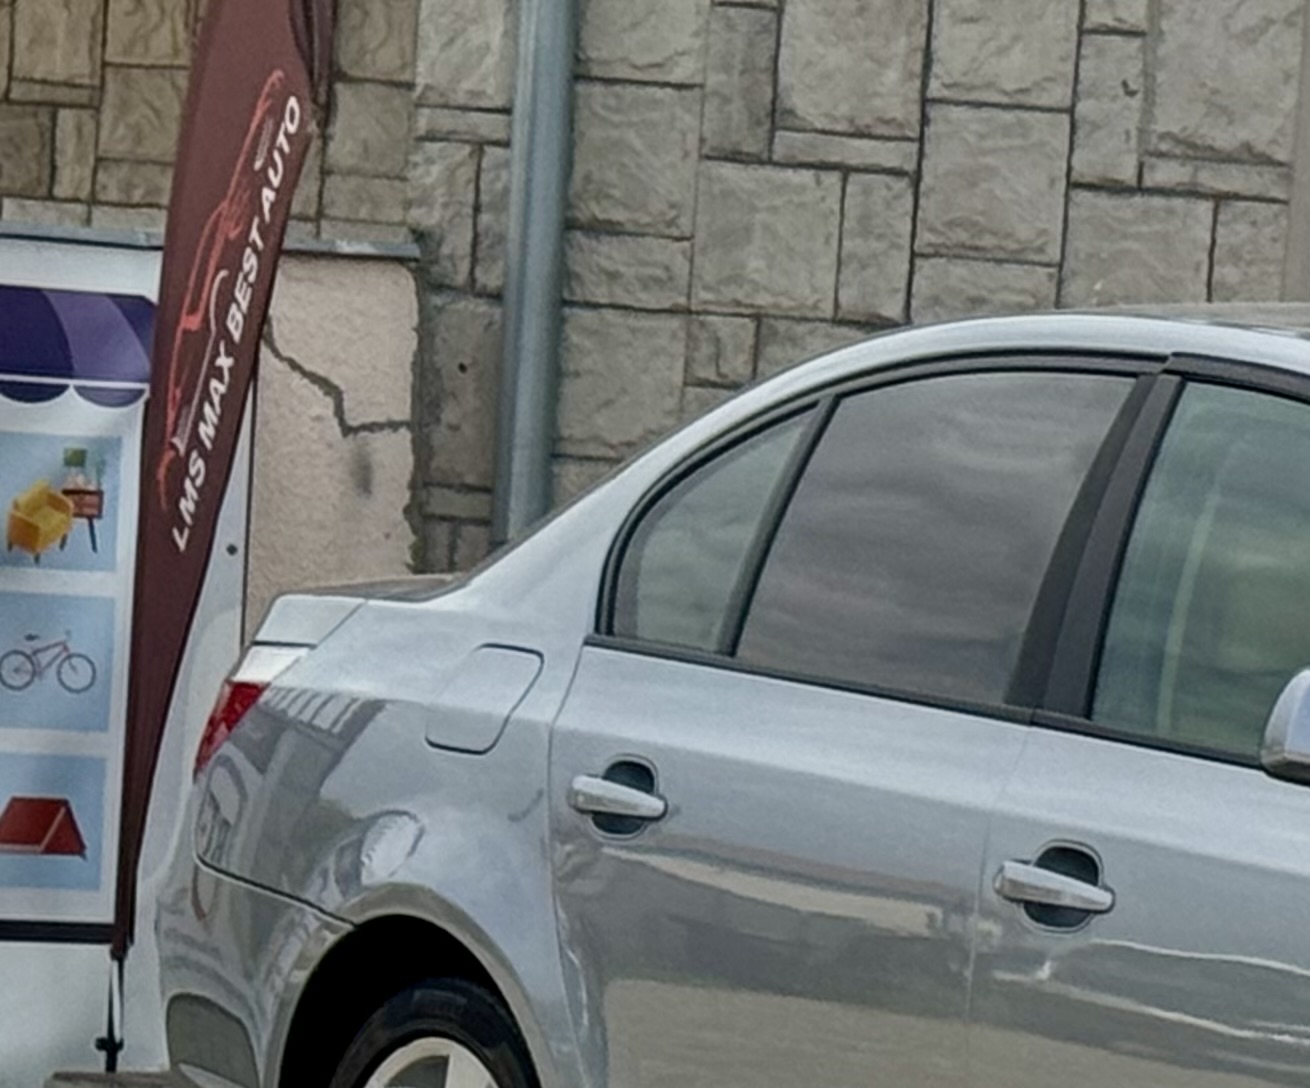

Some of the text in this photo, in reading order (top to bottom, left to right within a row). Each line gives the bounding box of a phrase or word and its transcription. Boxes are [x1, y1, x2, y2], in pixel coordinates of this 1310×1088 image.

[171, 95, 301, 552] LMS MAX BEST AUTO
